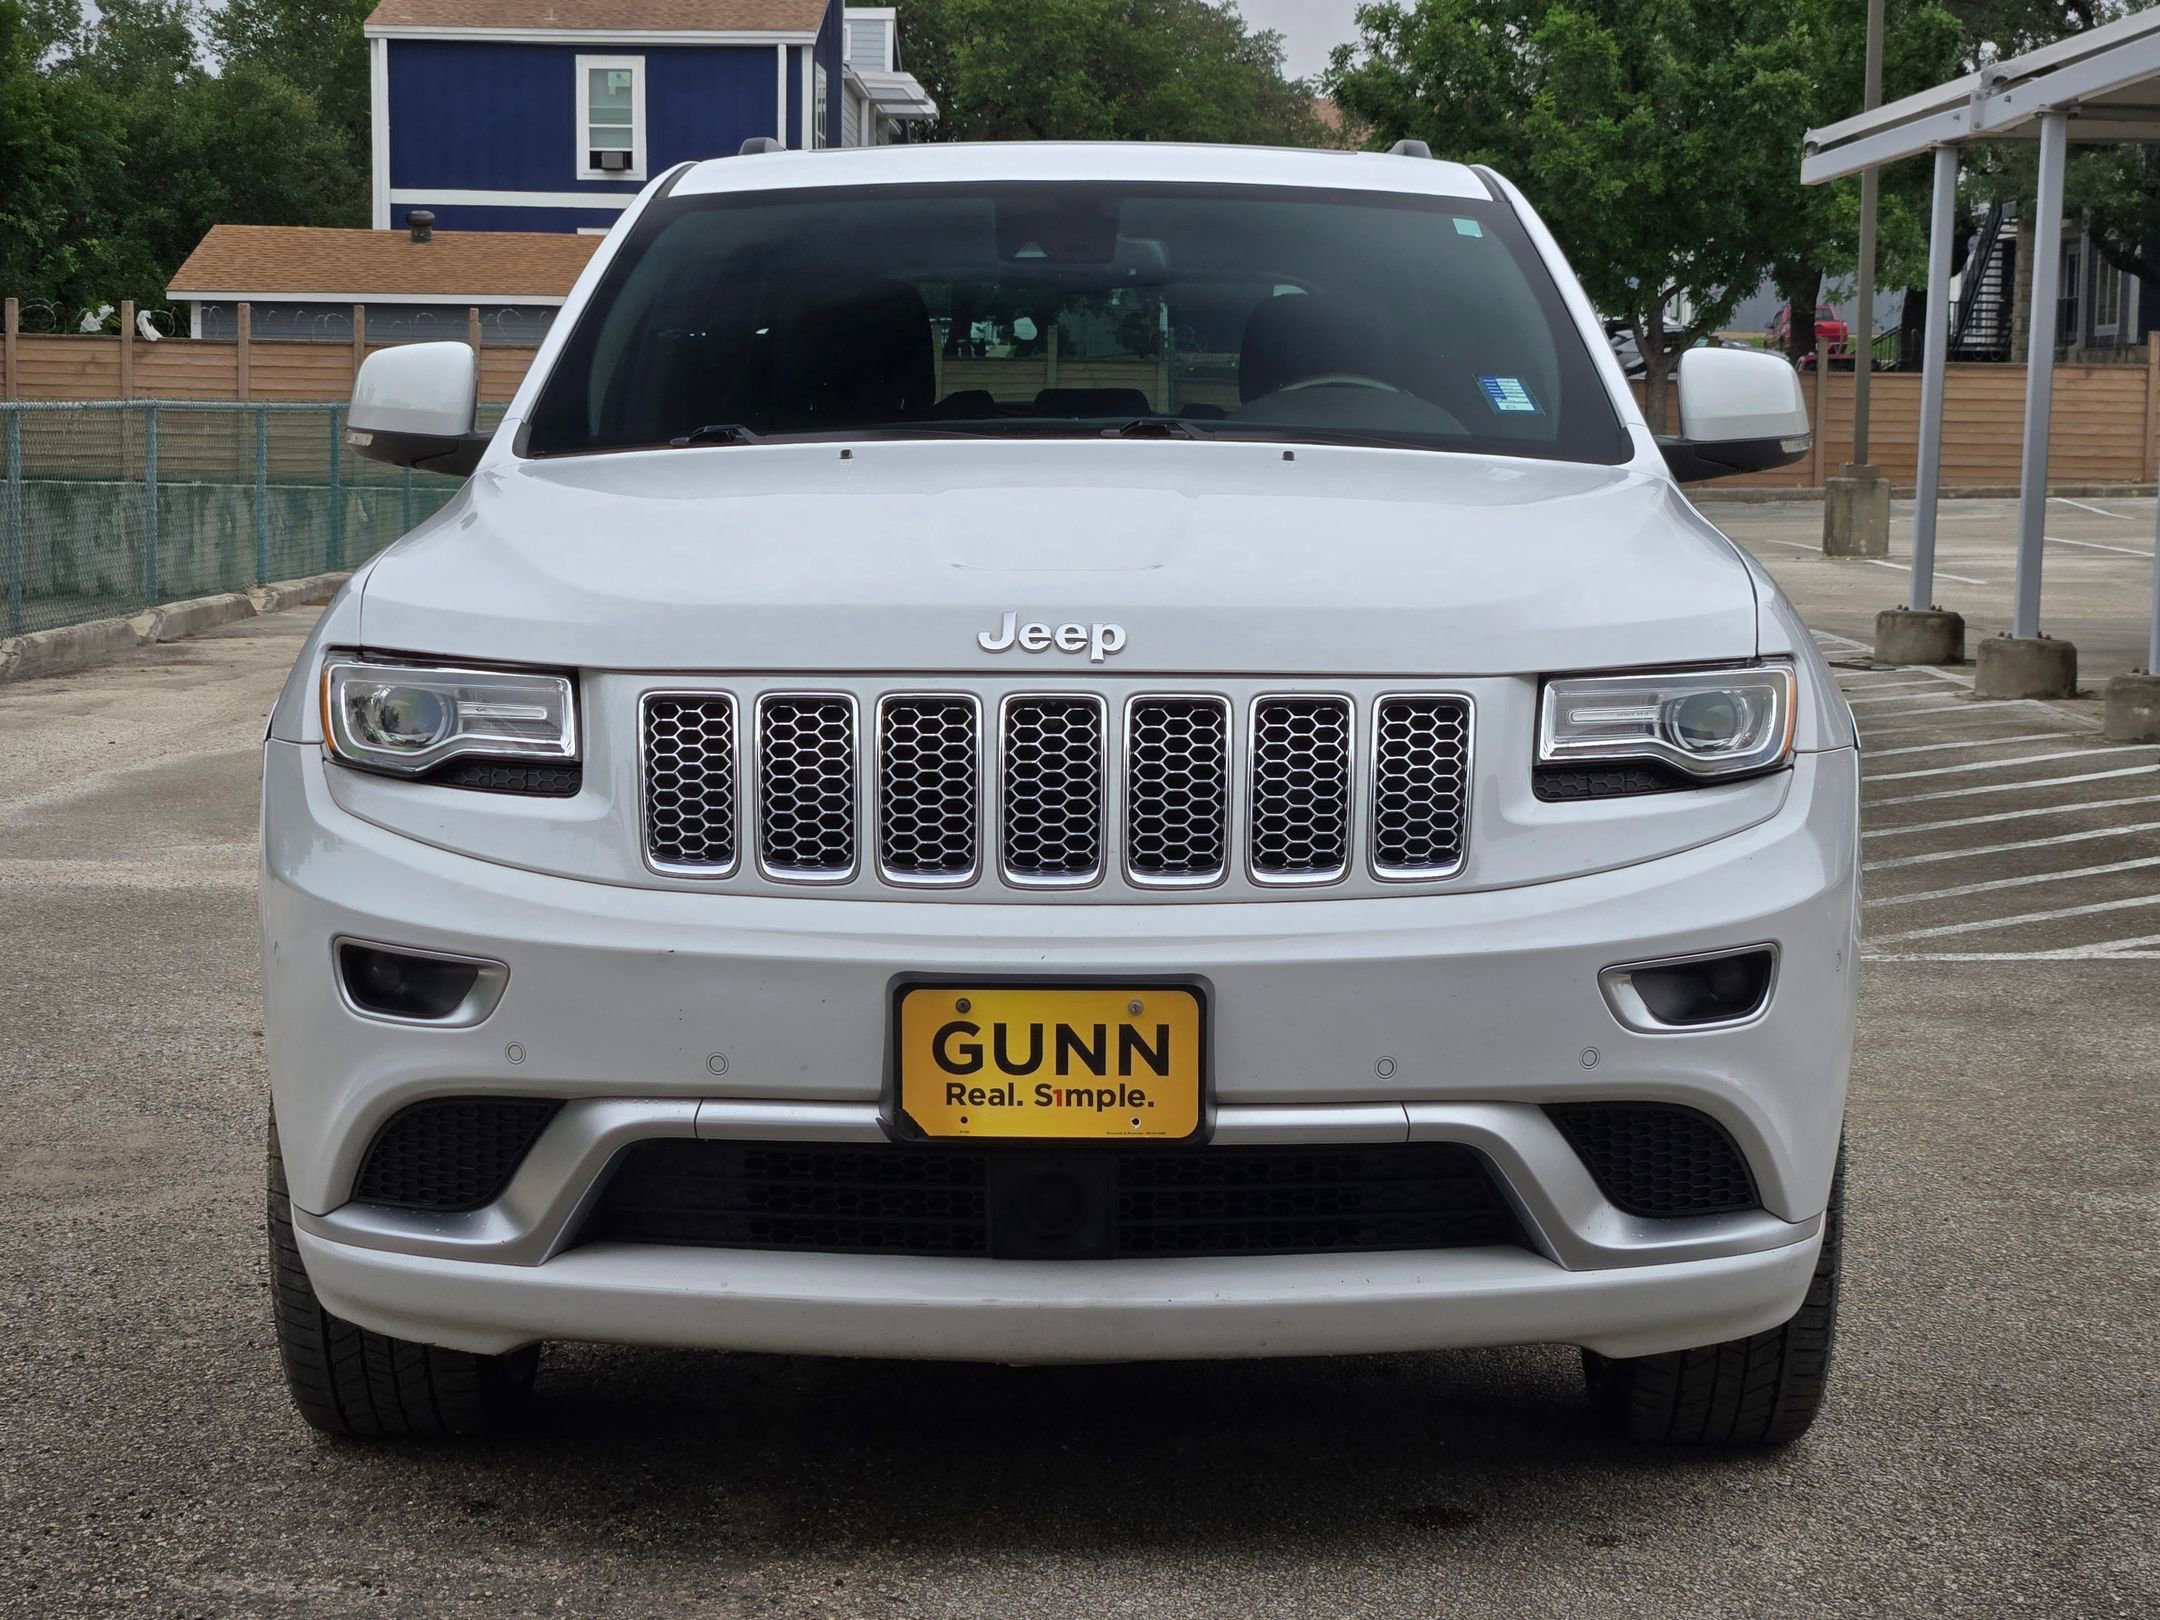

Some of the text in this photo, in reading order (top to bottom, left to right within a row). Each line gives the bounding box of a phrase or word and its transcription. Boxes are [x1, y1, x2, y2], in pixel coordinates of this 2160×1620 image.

[977, 611, 1127, 663] Jeep
[932, 1020, 1170, 1076] GUNN
[946, 1082, 1023, 1107] Real.
